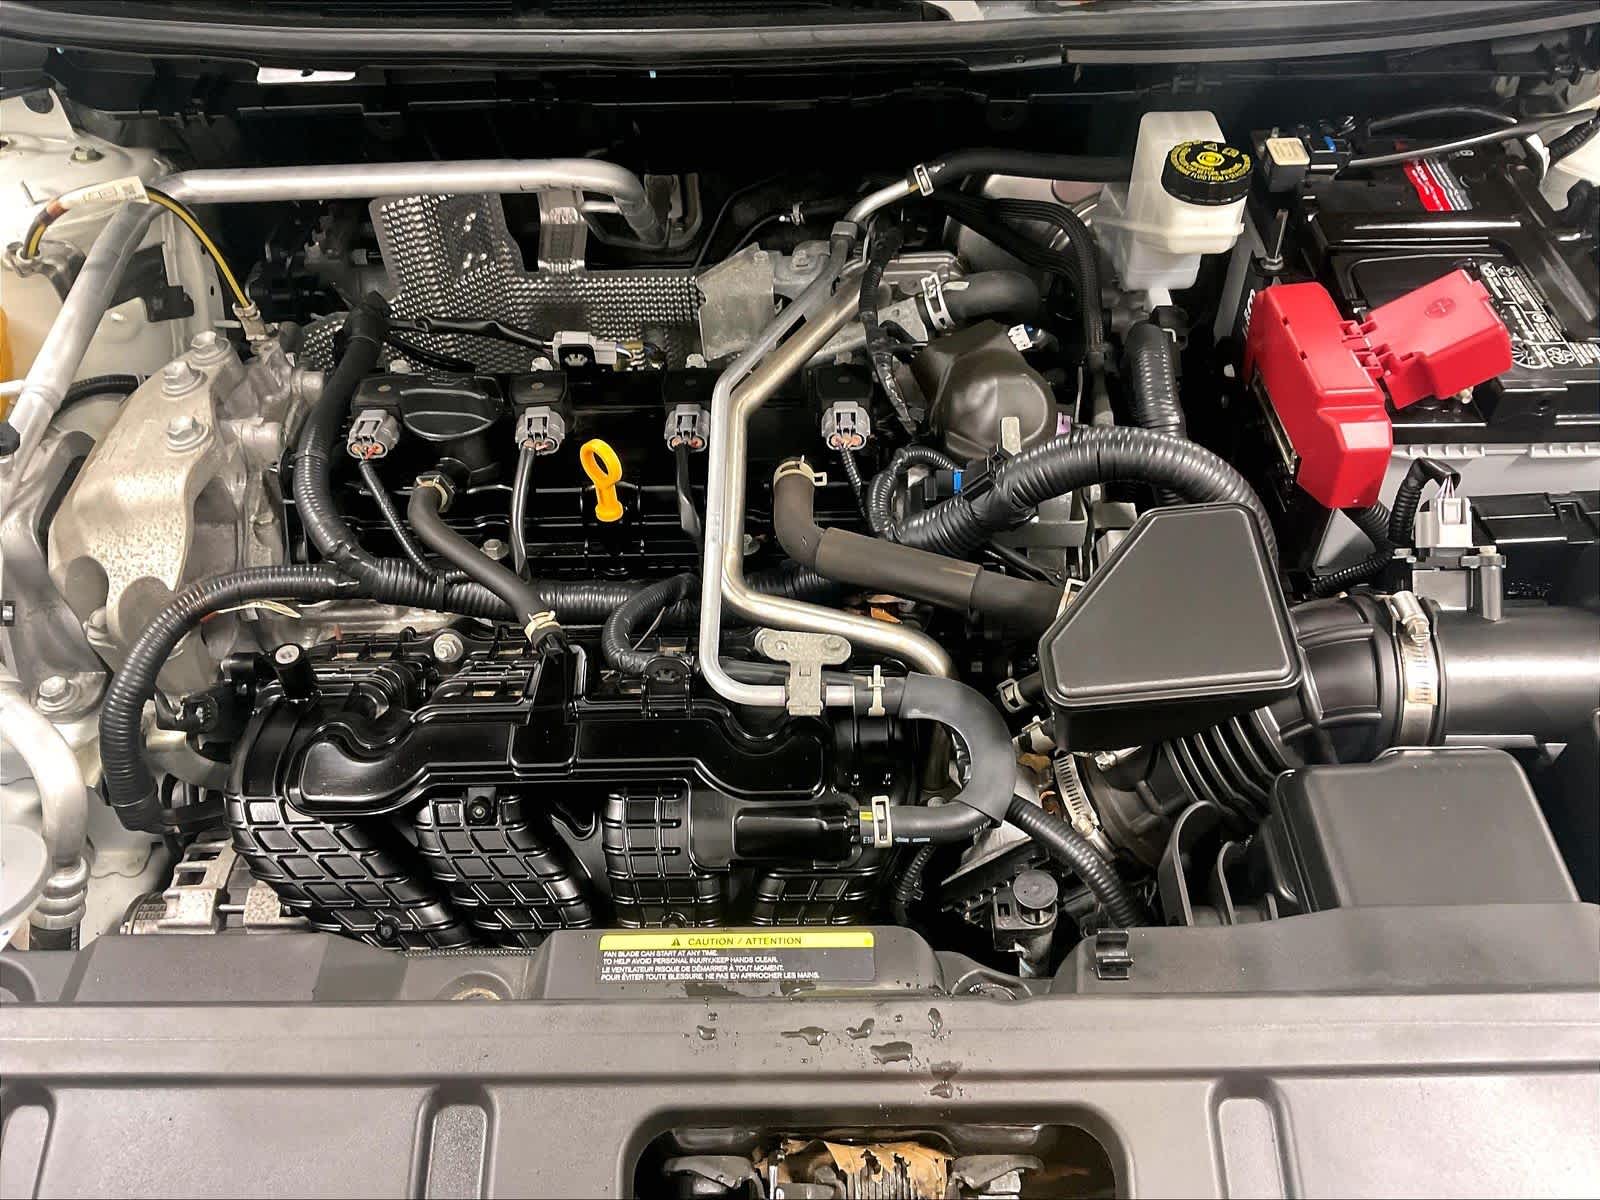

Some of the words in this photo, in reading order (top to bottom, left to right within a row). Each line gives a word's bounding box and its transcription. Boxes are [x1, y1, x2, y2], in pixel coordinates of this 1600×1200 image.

[687, 937, 734, 946] CAUTION
[745, 937, 802, 945] ATTENTION
[692, 964, 728, 972] DÉMARRER
[729, 963, 734, 971] À
[621, 972, 644, 980] ÉVITER
